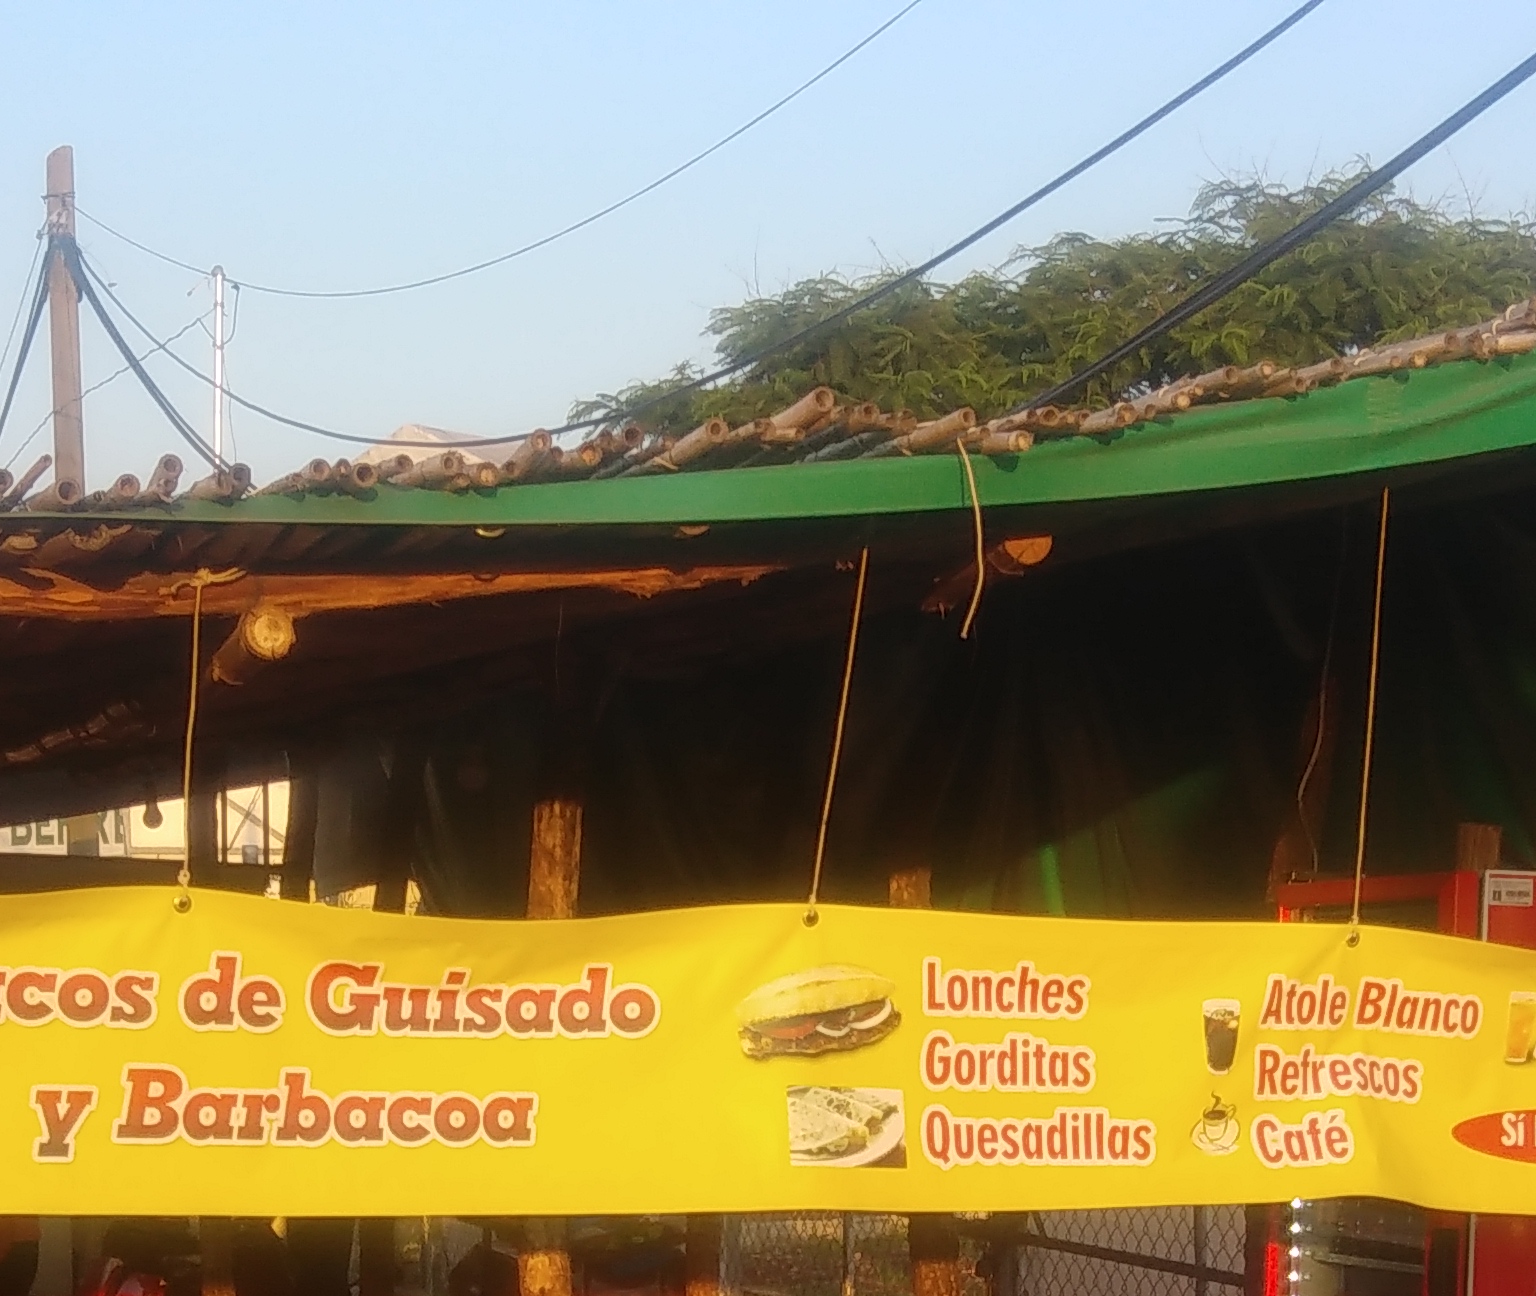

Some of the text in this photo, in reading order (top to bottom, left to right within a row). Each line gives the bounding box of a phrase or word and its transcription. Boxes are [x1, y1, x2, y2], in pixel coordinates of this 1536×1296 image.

[183, 955, 282, 1029] de
[310, 962, 657, 1035] Guisado
[925, 961, 1087, 1016] Lonches
[1260, 979, 1480, 1034] Atole Blanco
[925, 1035, 1093, 1088] Gorditas
[1256, 1048, 1420, 1099] Refrescos
[33, 1067, 535, 1160] y Barbacoa
[925, 1110, 1153, 1165] Quesadillas
[1255, 1114, 1349, 1164] Café
[1500, 1112, 1526, 1147] Sí
